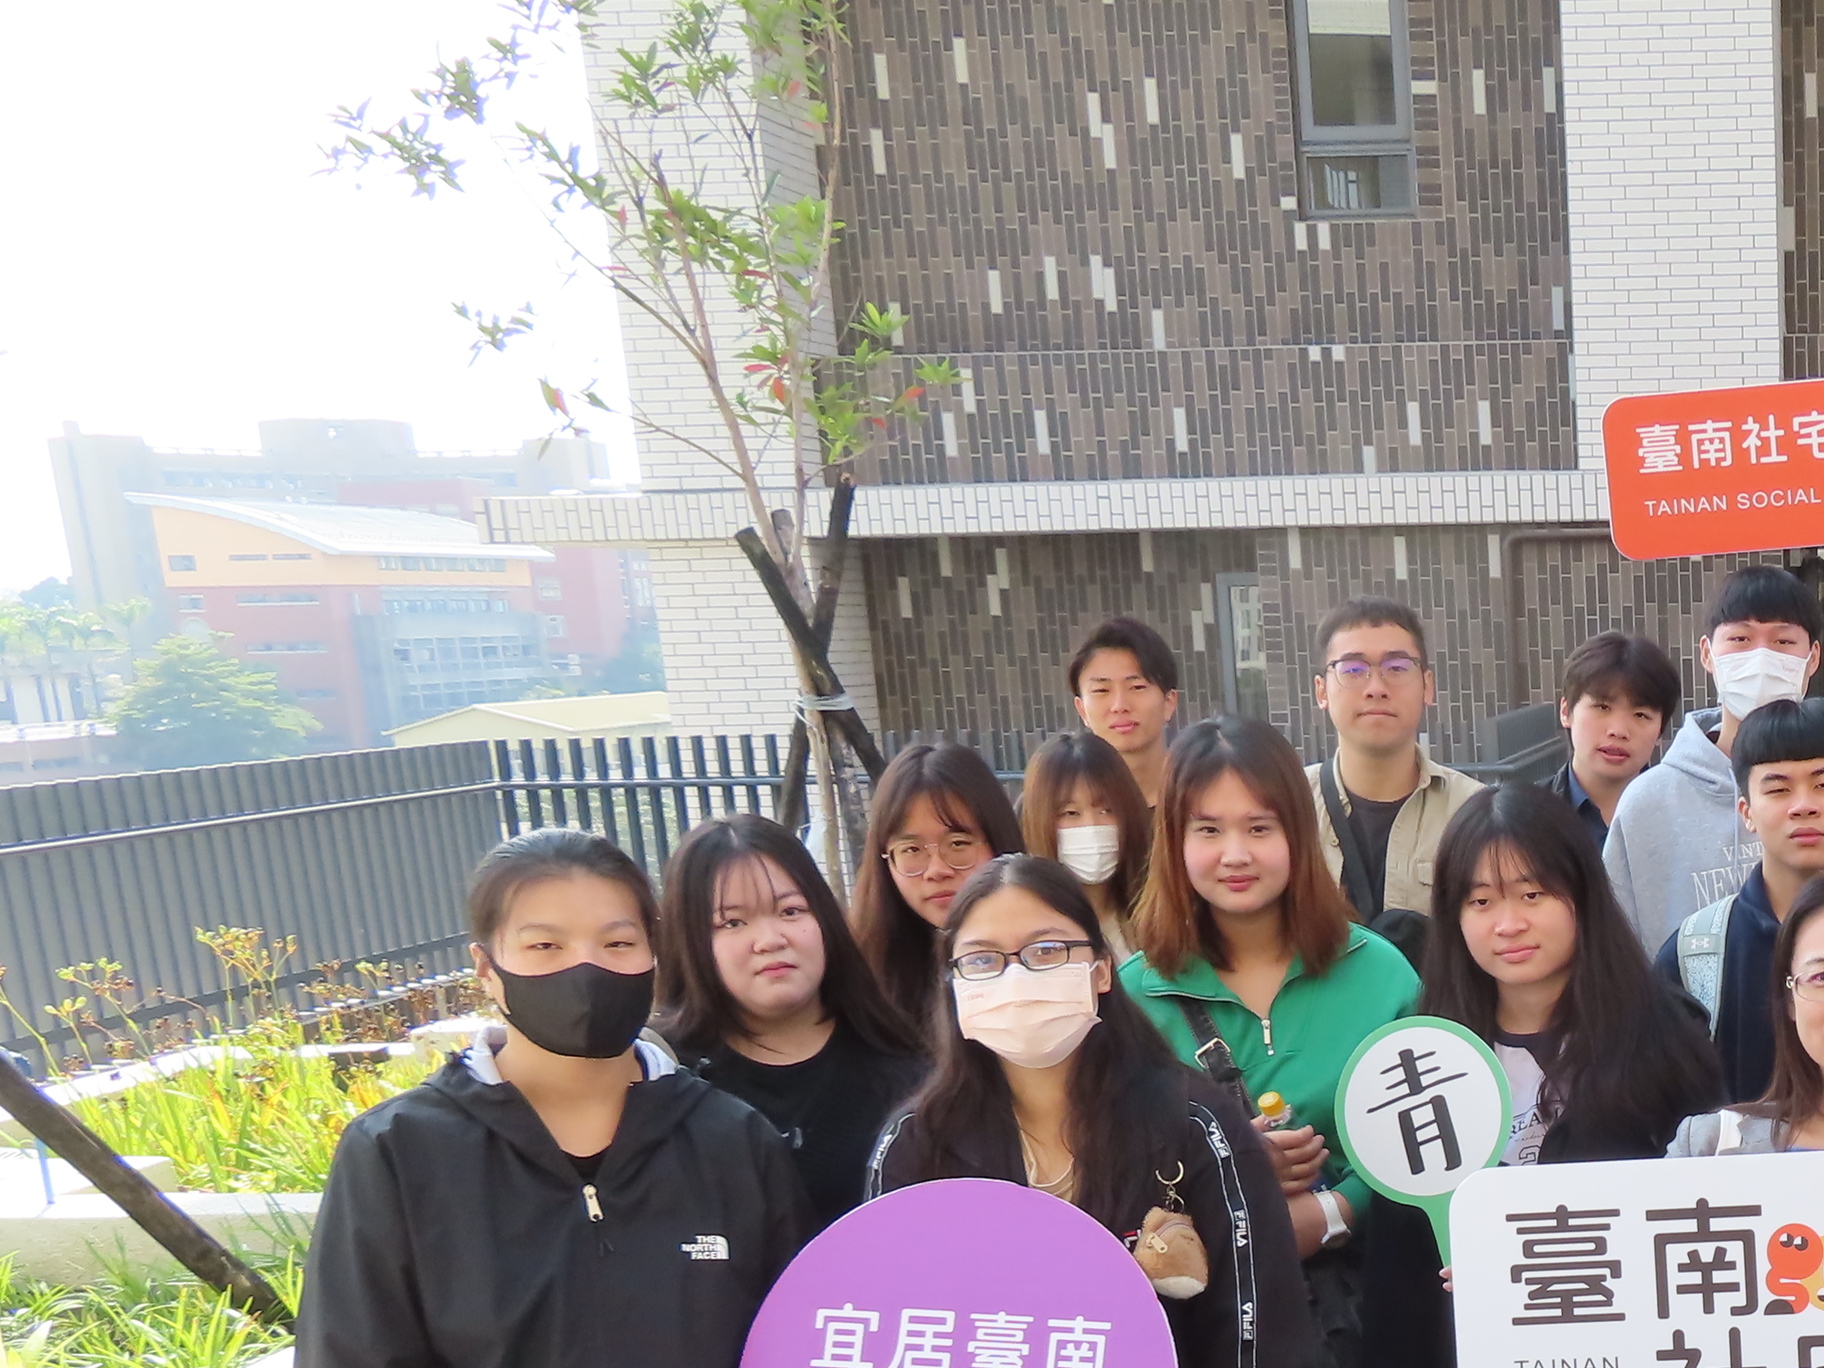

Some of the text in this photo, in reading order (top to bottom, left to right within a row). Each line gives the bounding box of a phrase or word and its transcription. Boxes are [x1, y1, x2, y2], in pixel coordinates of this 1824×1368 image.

[1644, 494, 1728, 518] TAINAN
[1736, 488, 1823, 510] SOCIAL
[1366, 1048, 1469, 1176] 青
[680, 1244, 719, 1252] NORTH
[695, 1235, 717, 1244] THE
[691, 1252, 717, 1260] FACE
[1505, 1197, 1763, 1327] 臺南
[1242, 1302, 1253, 1330] FILA
